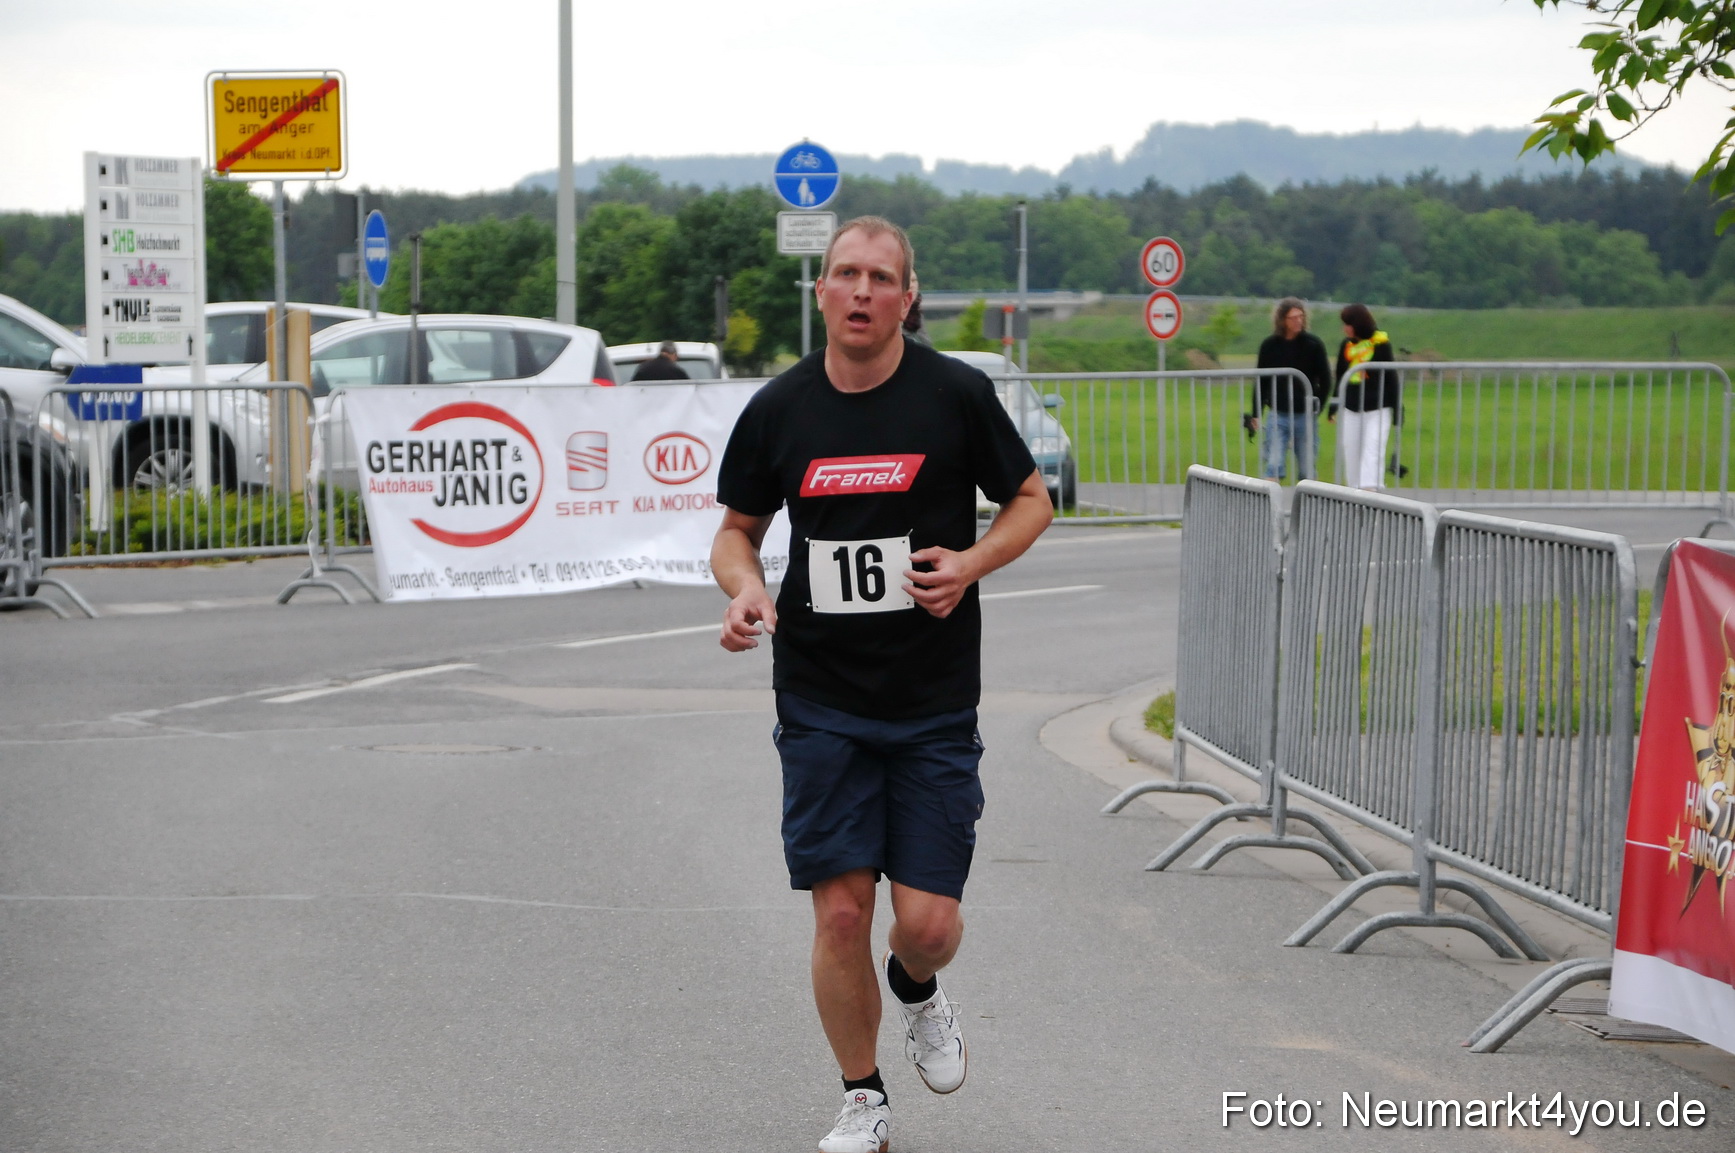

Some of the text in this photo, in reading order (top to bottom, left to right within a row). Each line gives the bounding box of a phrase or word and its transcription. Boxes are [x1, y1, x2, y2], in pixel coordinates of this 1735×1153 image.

[223, 88, 329, 119] Sengenthal
[269, 121, 315, 138] Anger
[250, 149, 296, 160] Neumarkt
[136, 232, 180, 250] Holzfachmarkt
[1152, 251, 1175, 273] 60
[112, 298, 150, 322] THULE
[366, 438, 523, 474] GERHART &
[655, 444, 698, 472] KIA
[368, 477, 434, 494] Autohaus
[809, 461, 906, 489] Franek
[432, 471, 528, 507] JÄNIG
[555, 500, 620, 516] SEAT
[632, 495, 656, 513] KIA
[444, 564, 518, 591] Sengenthal
[528, 562, 554, 584] Tel.
[832, 543, 887, 603] 16
